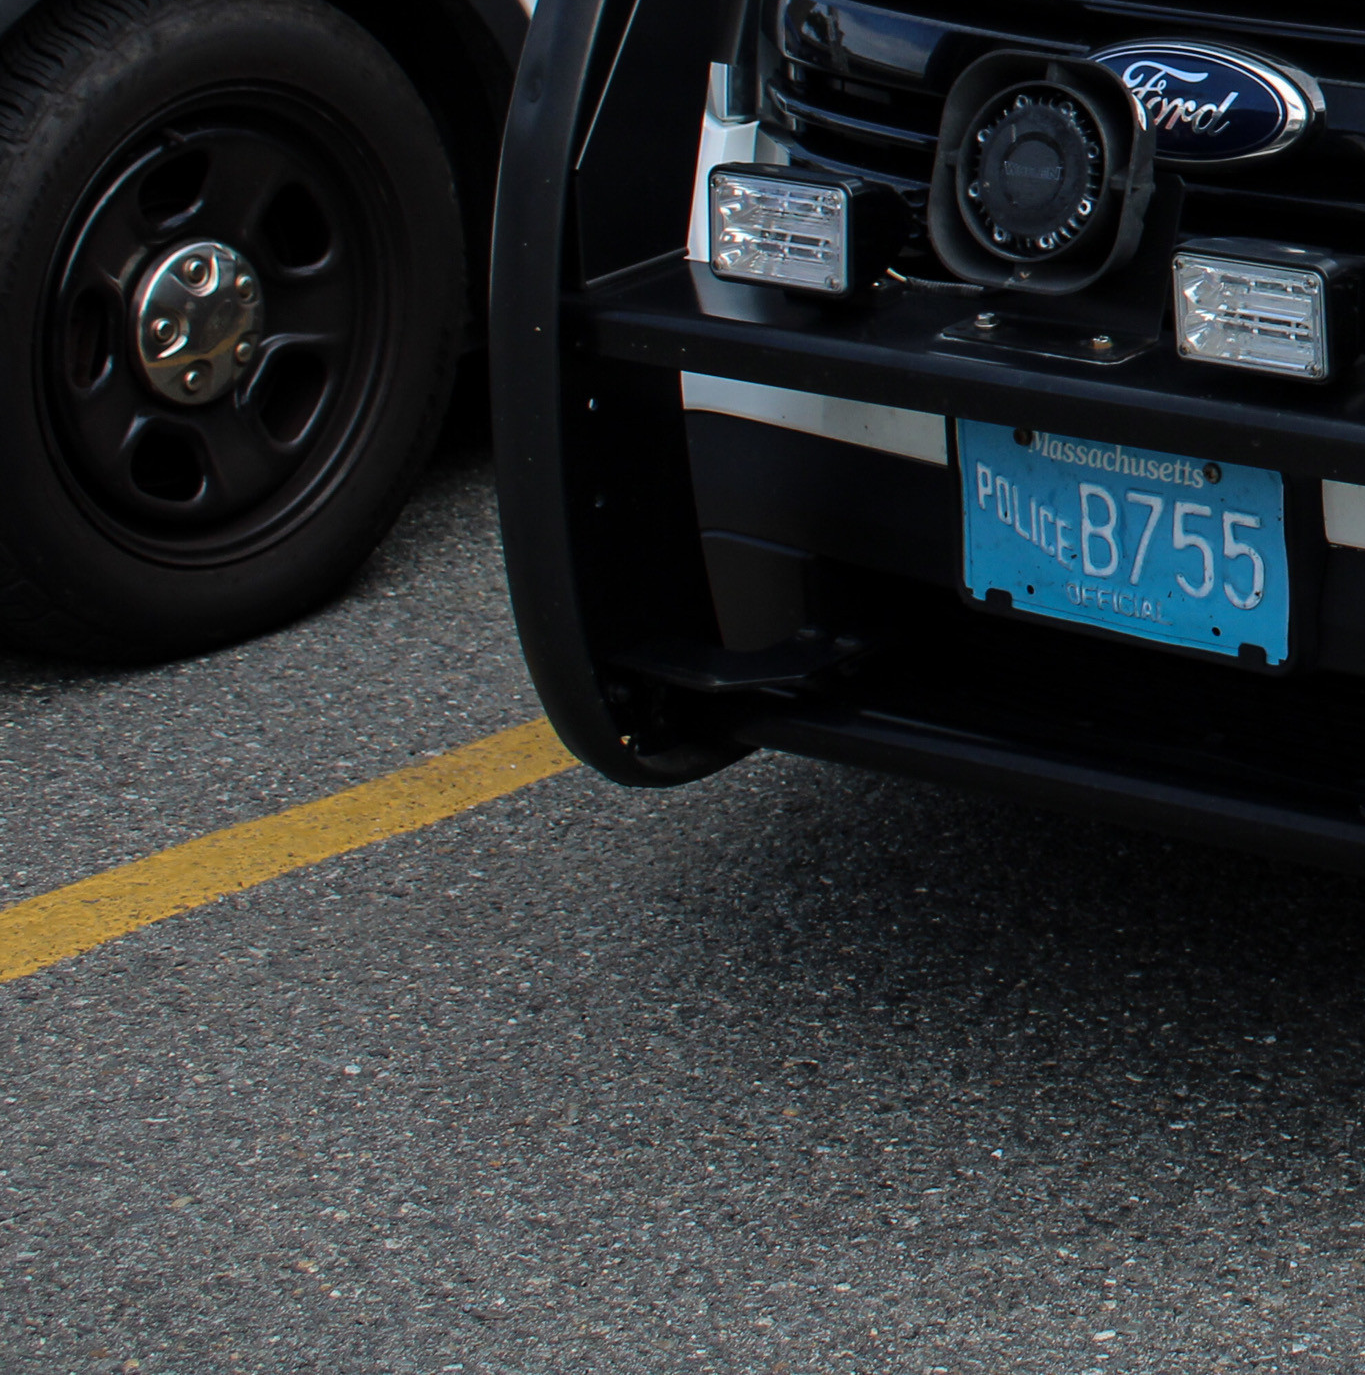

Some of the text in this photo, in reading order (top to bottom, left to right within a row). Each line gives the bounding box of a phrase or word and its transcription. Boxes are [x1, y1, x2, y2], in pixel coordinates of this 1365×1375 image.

[1122, 60, 1238, 135] Ford
[1028, 430, 1204, 489] Massachusetts
[975, 460, 1266, 610] POLICE B755
[1065, 581, 1173, 626] OFFICIAL
